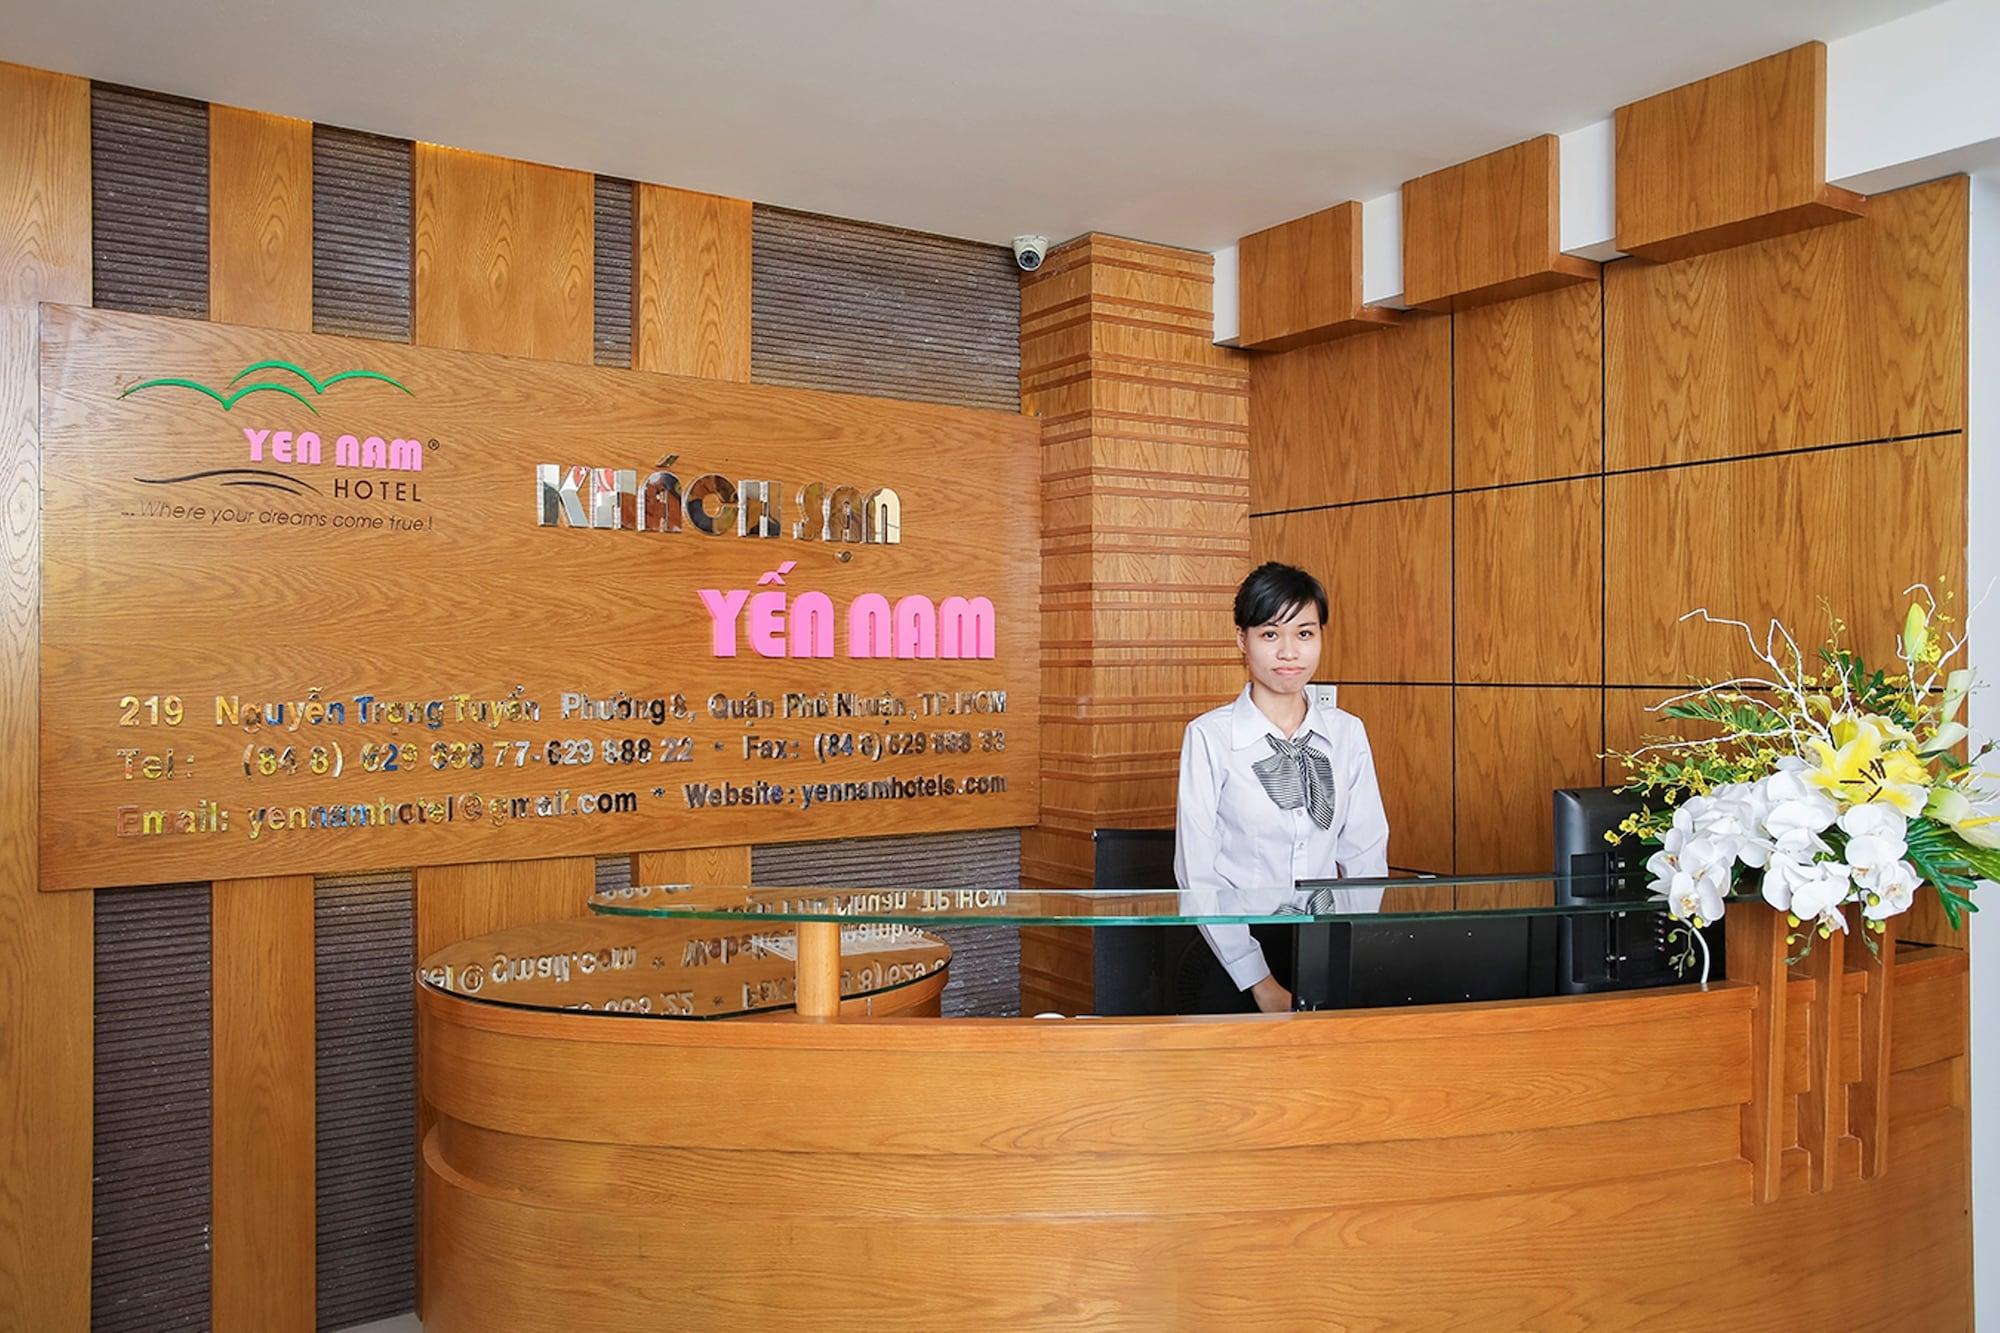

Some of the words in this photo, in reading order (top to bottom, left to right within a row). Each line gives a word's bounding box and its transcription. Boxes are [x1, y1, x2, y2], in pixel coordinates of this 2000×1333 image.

[243, 428, 321, 465] YEN
[335, 434, 423, 472] NAM
[333, 478, 422, 503] HOTEL
[211, 508, 254, 526] your
[258, 508, 327, 527] dreams
[332, 514, 384, 531] come
[697, 561, 834, 658] YẾN
[847, 592, 996, 659] NAM
[119, 695, 185, 726] 219
[214, 687, 345, 734] Nguyễn
[707, 691, 775, 728] Quận
[360, 741, 419, 773] 629
[602, 738, 652, 766] 888
[659, 735, 694, 764] 22
